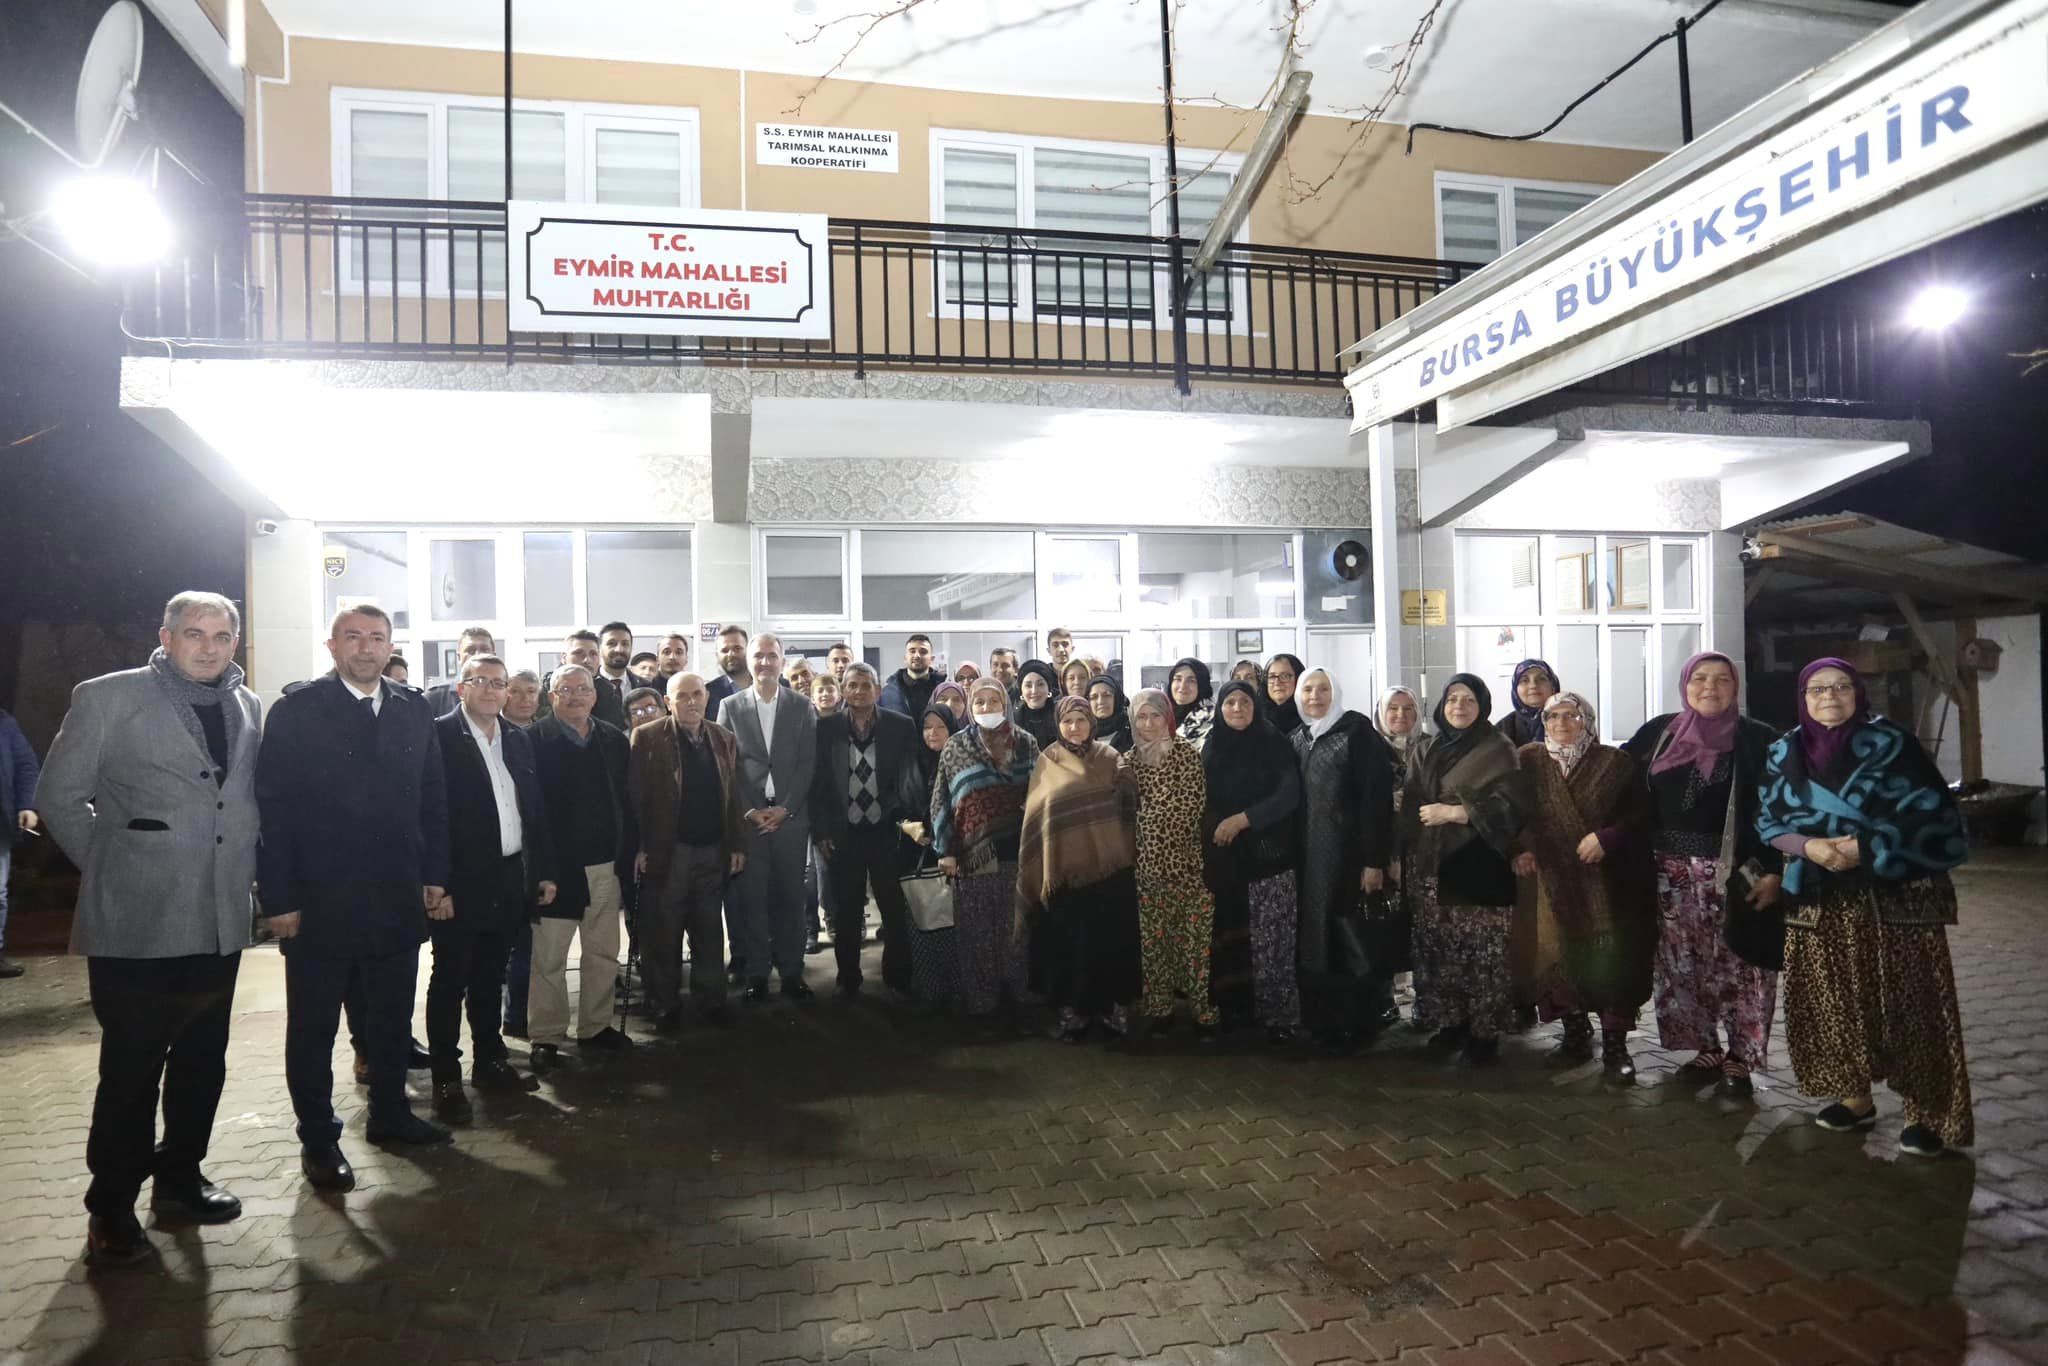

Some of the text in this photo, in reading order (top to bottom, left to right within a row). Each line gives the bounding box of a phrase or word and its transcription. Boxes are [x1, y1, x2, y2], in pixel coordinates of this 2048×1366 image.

[763, 127, 893, 143] S.S. EYMİR MAHALLESİ
[767, 141, 889, 156] TARIMSAL KALKINMA
[790, 156, 867, 169] KOOPERATİFİ
[648, 233, 695, 252] T.C.
[1419, 85, 1973, 387] BURSA BÜYÜKŞEHİR
[553, 253, 788, 284] EYMİR MAHALLESİ
[593, 287, 751, 311] MUHTARLIĞI
